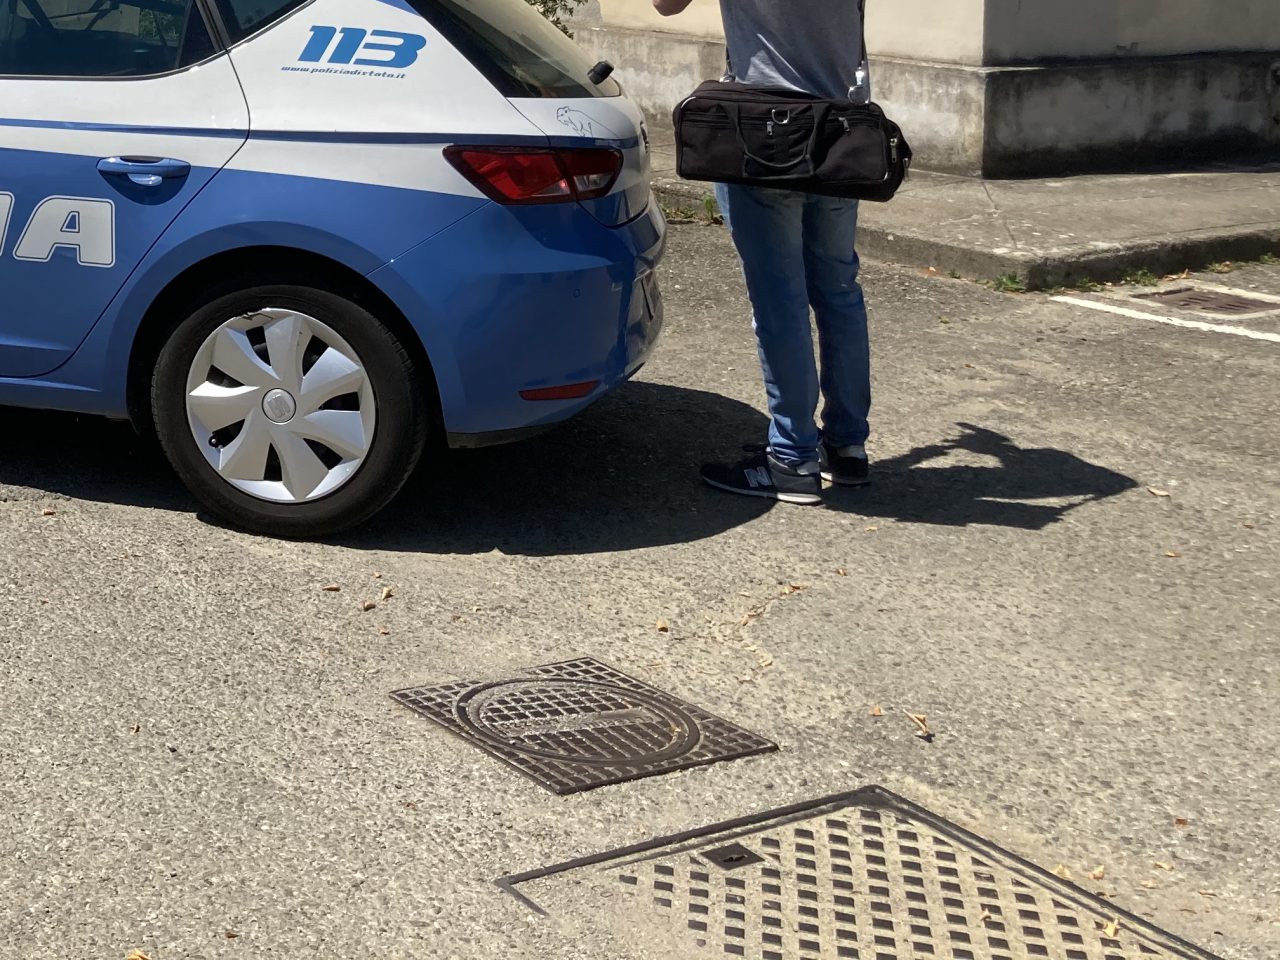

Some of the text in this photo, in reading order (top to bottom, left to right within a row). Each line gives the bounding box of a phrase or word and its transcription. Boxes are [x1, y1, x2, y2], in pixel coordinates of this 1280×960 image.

[297, 25, 427, 69] 113
[280, 66, 406, 79] www.poliziadistato.it
[743, 466, 774, 488] N
